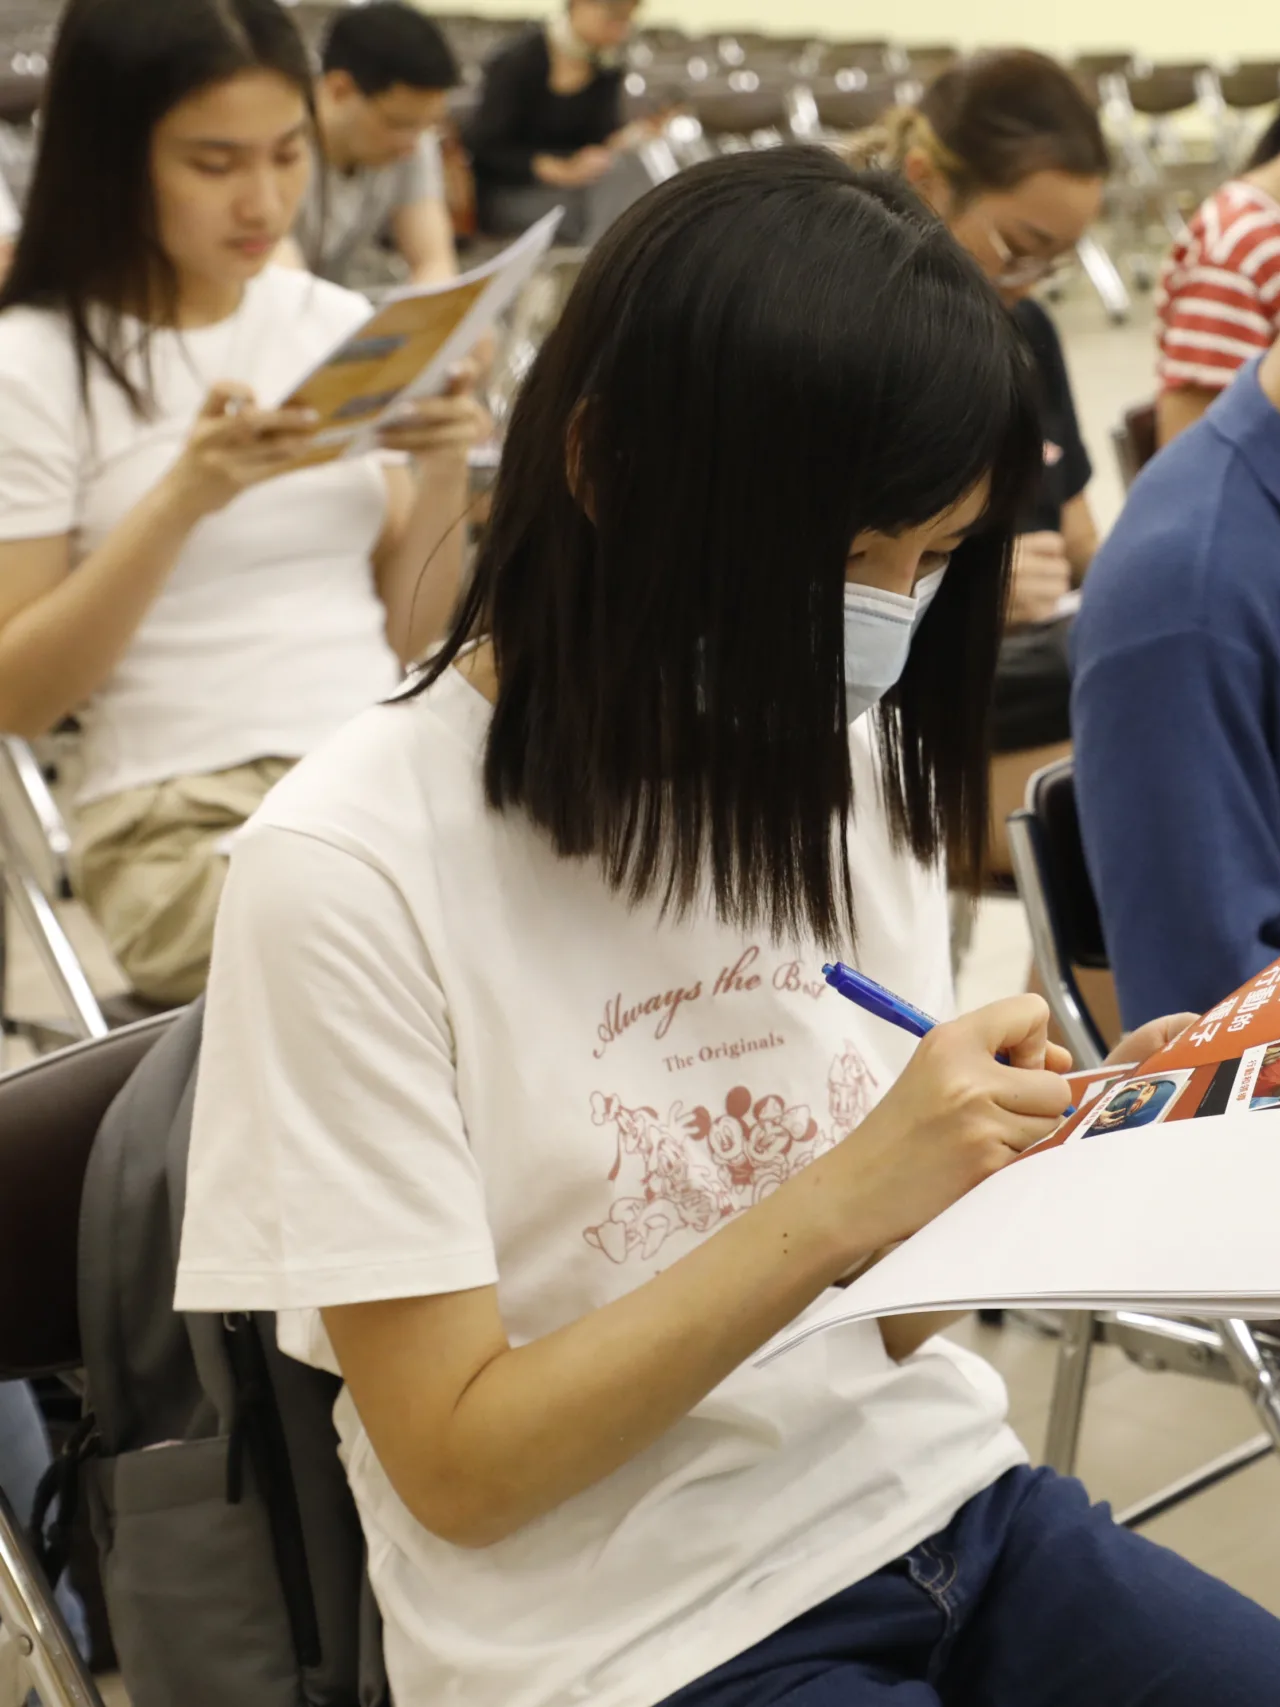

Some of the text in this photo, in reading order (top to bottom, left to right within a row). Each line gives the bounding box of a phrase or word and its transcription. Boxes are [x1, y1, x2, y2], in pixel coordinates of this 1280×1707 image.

[593, 980, 703, 1060] Always
[713, 945, 762, 996] the
[662, 1032, 785, 1073] The Originals
